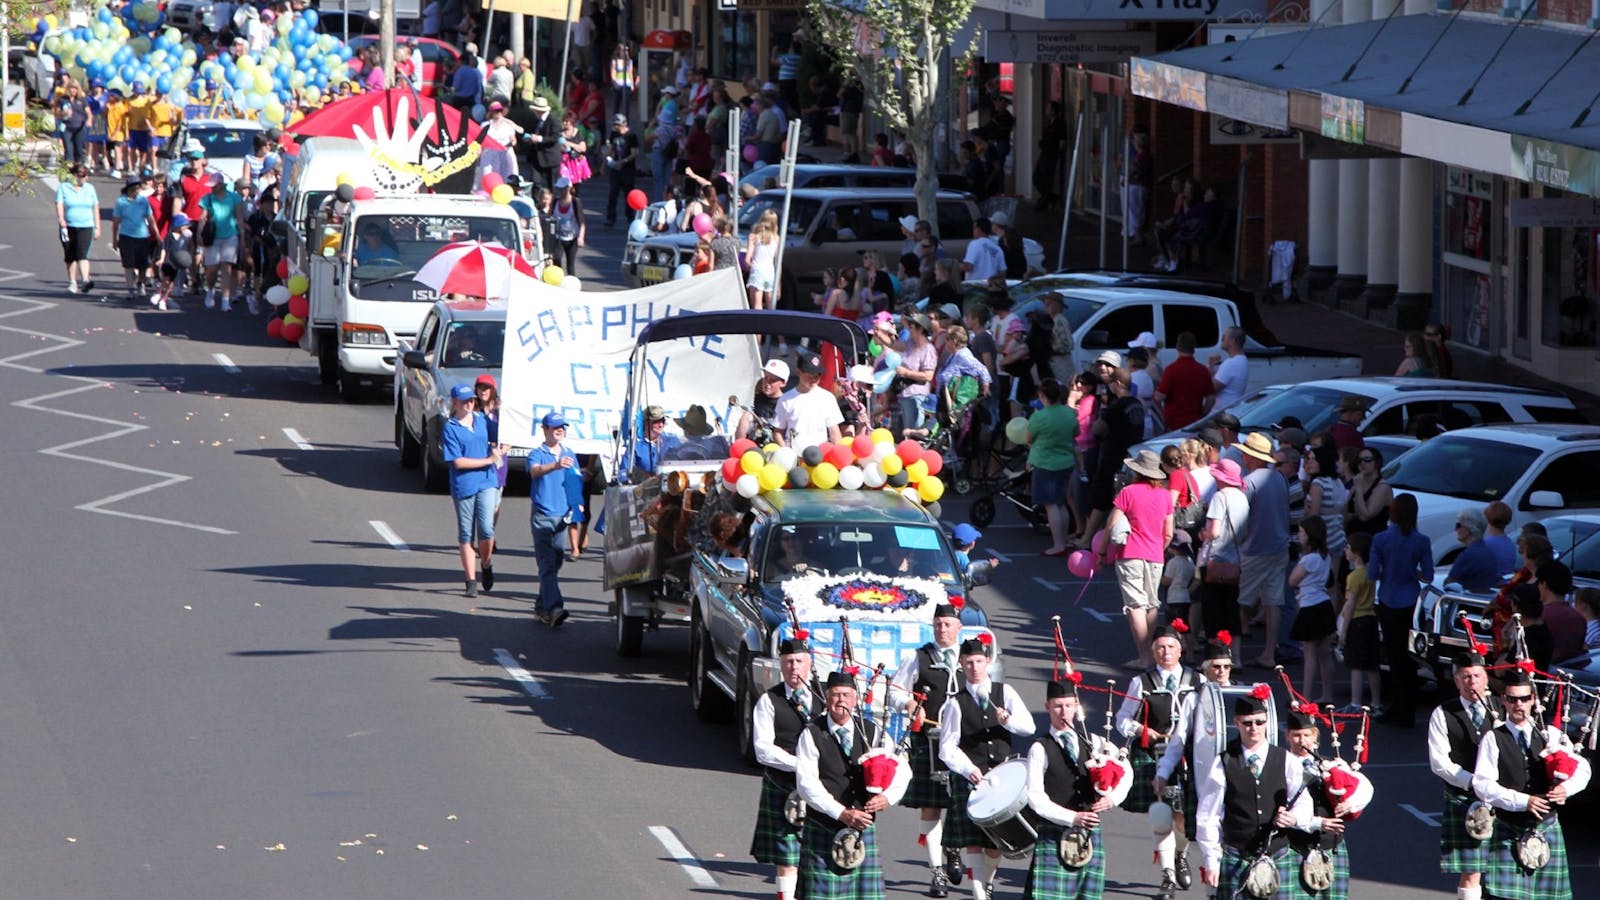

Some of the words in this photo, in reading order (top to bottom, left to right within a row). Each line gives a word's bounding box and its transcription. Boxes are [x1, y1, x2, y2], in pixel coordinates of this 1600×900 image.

[1037, 33, 1076, 42] Inverell
[1037, 43, 1093, 54] Diagnostic
[1097, 43, 1140, 54] Imaging
[570, 356, 670, 395] CITY
